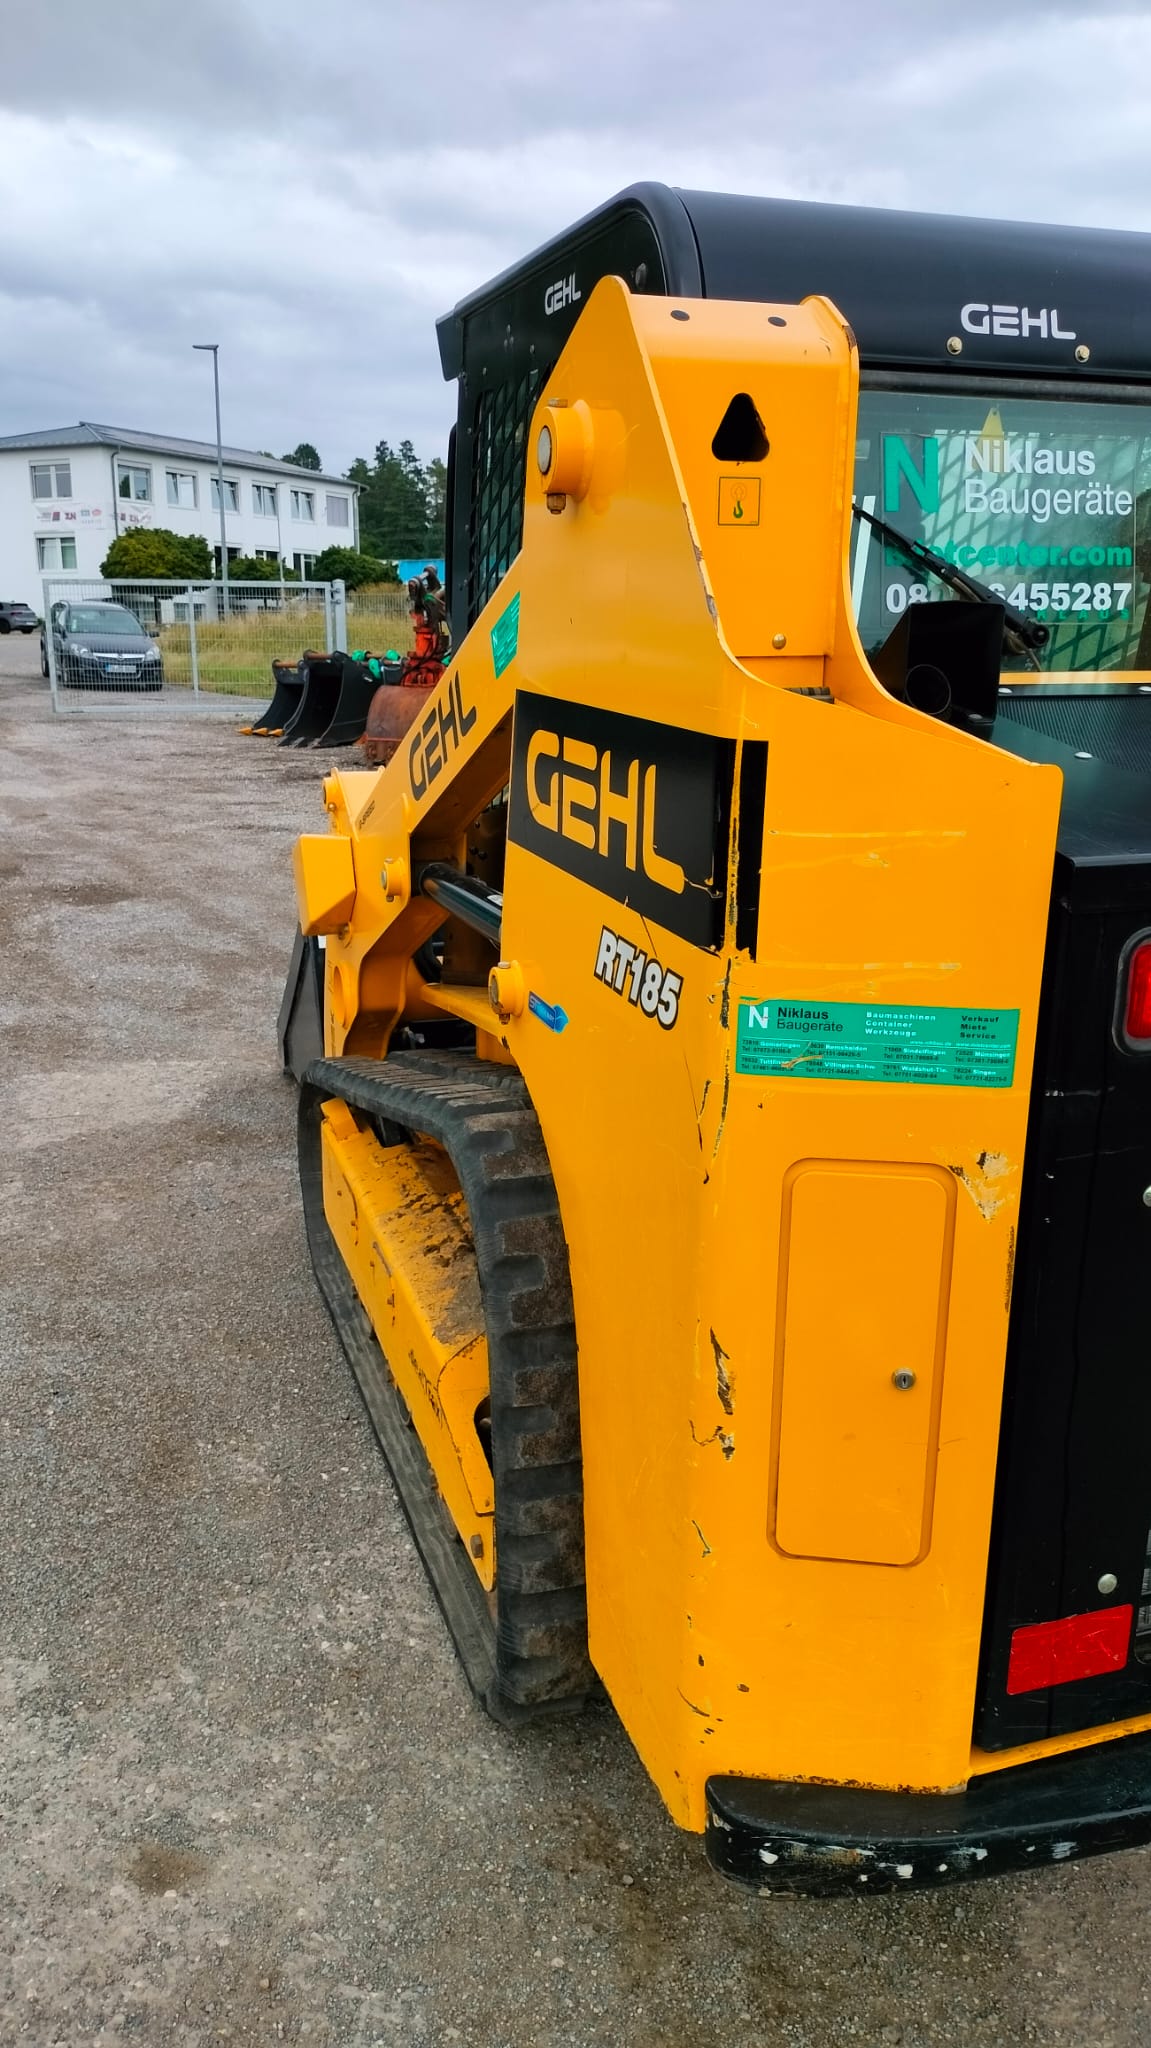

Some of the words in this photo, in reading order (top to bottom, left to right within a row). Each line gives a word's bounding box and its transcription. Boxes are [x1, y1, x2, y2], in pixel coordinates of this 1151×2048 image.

[545, 272, 582, 316] GEHL
[960, 303, 1077, 340] GEHL
[883, 436, 939, 513] N
[964, 438, 1096, 475] Niklaus
[964, 478, 1134, 523] Baugeräte
[408, 671, 478, 801] GEHL
[526, 729, 686, 895] GEHL
[593, 924, 685, 1031] RT185
[748, 1004, 769, 1029] N
[777, 1006, 829, 1020] Niklaus
[865, 1020, 913, 1028] Container
[866, 1011, 936, 1021] Baumaschinen
[961, 1015, 999, 1023] Verkauf
[864, 1028, 917, 1037] Werkzeuge
[959, 1032, 996, 1040] Service
